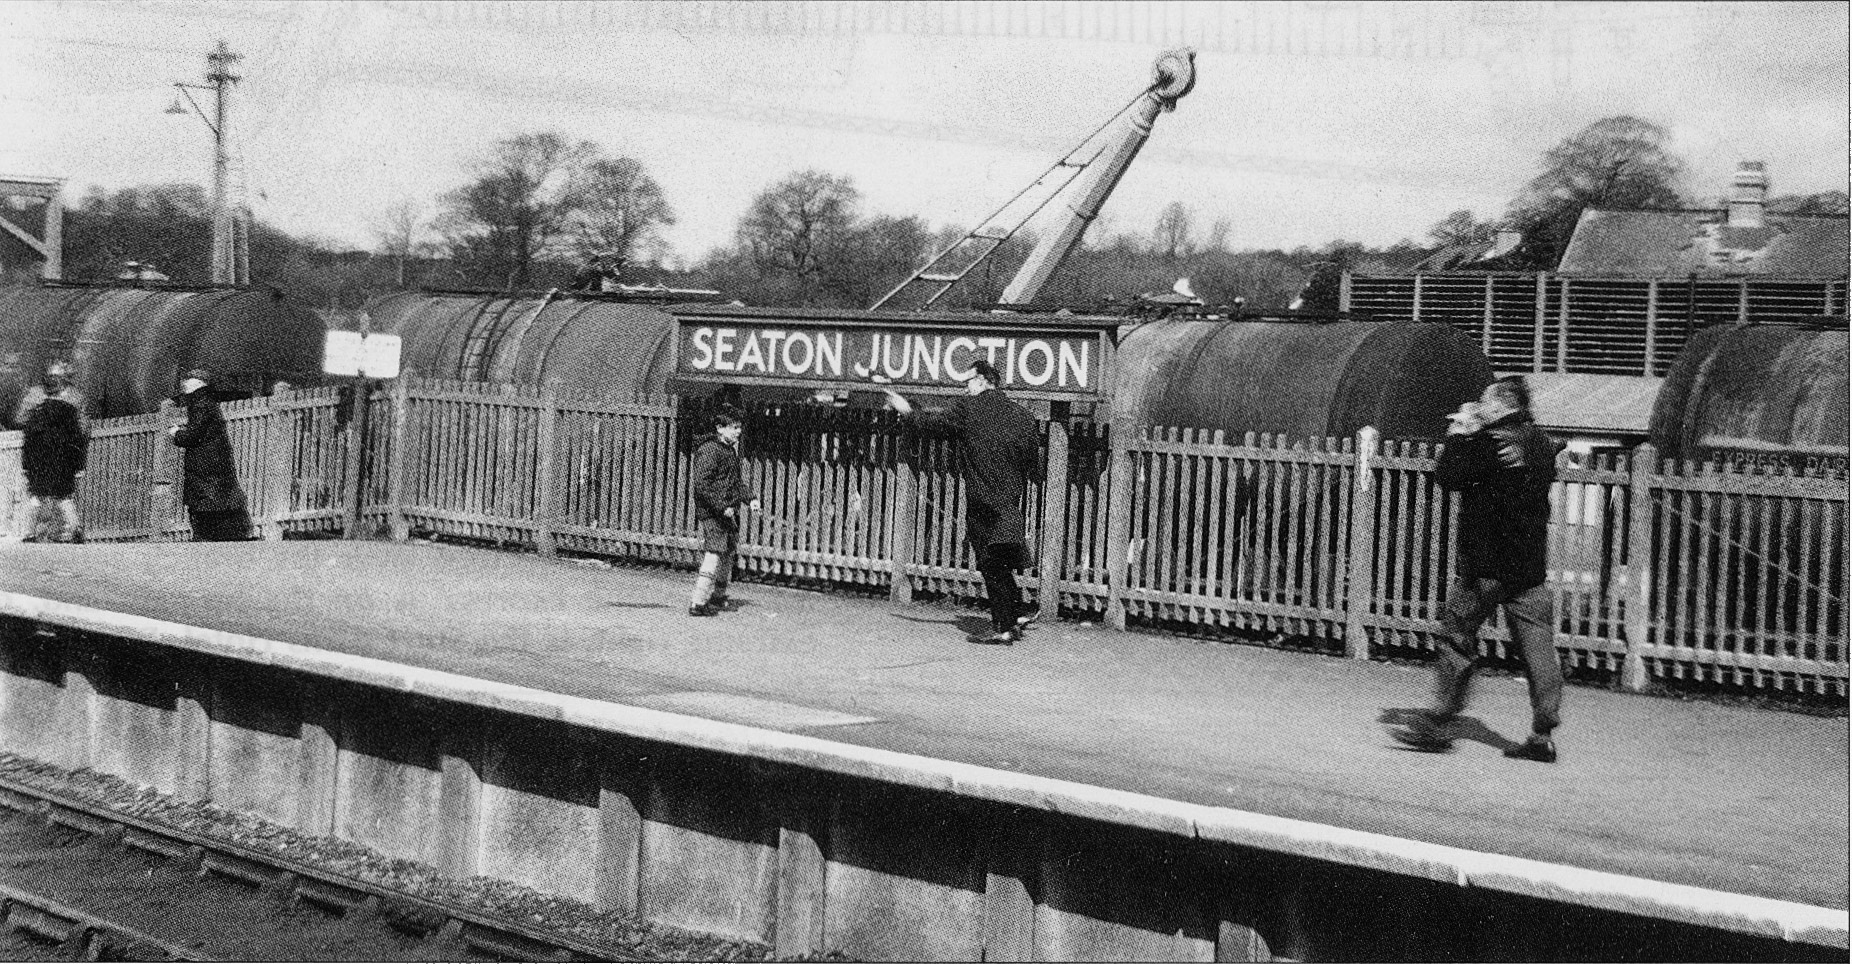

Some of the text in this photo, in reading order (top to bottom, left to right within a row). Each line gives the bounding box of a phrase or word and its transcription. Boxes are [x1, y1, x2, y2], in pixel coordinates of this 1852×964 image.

[692, 327, 1089, 387] SEATON JUNCTION
[1711, 450, 1790, 471] EXPRESS
